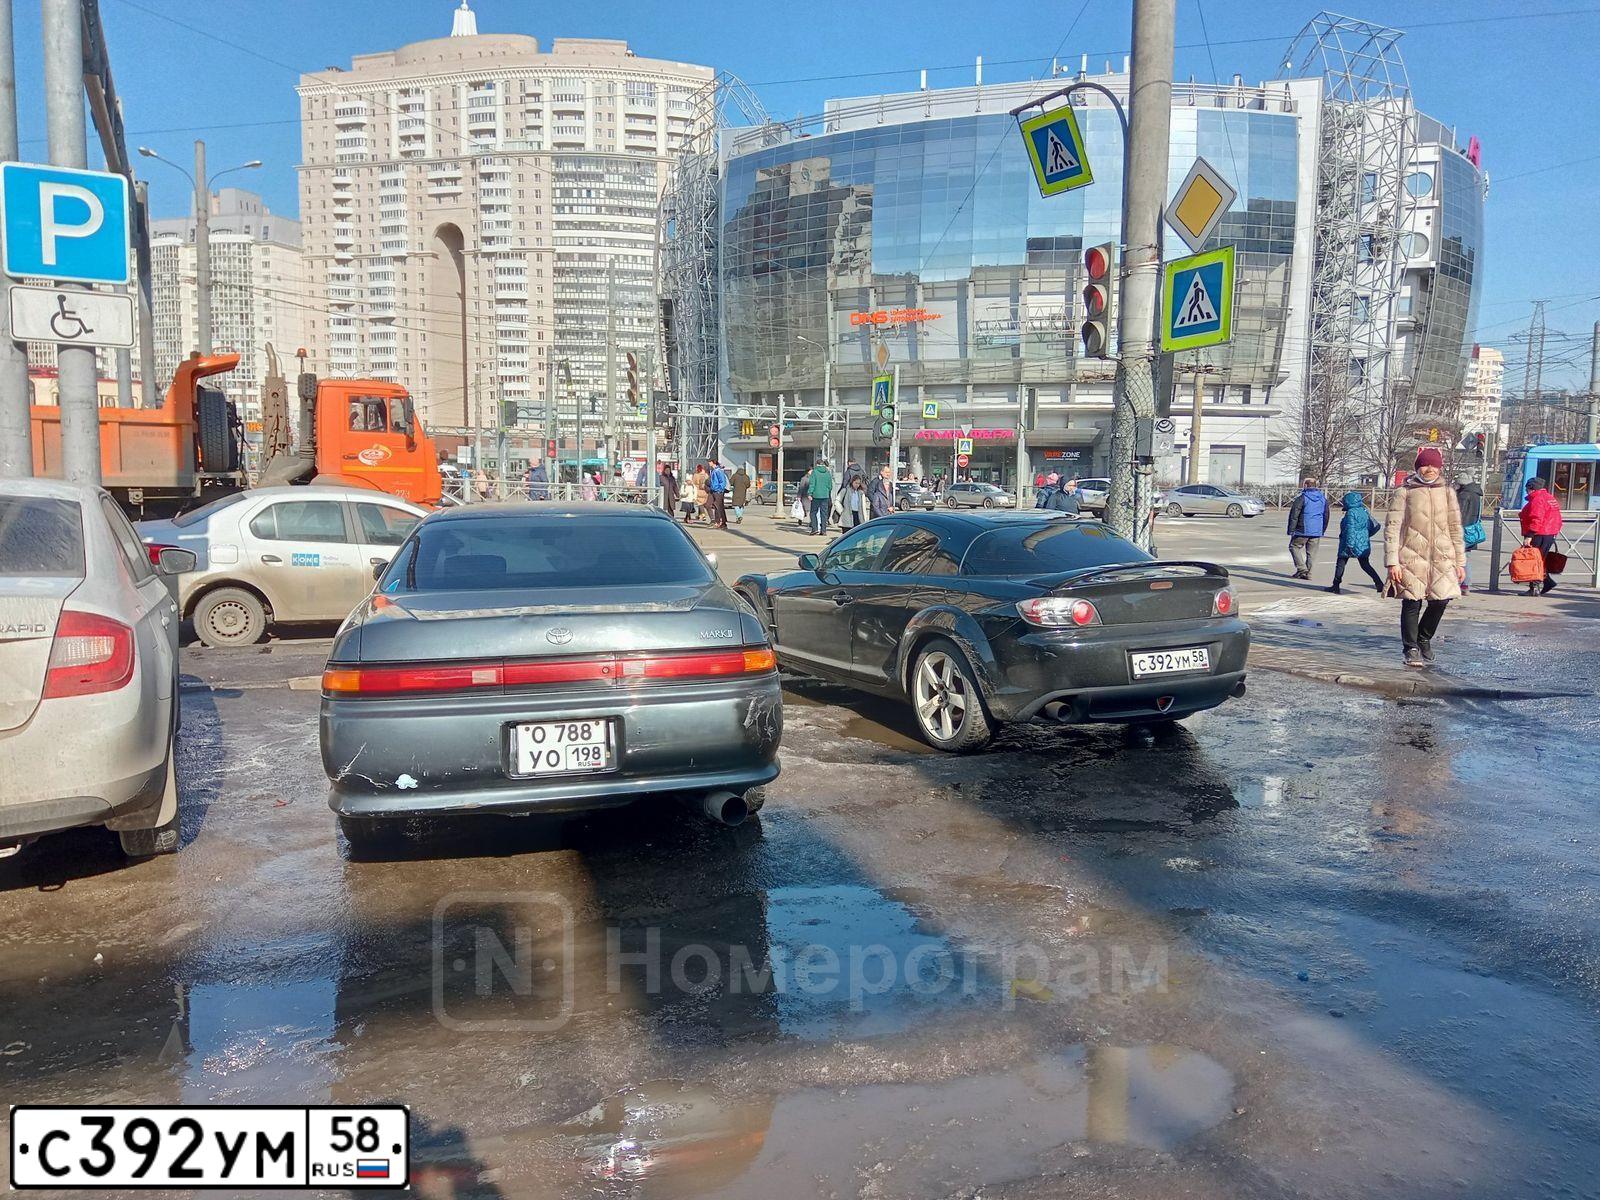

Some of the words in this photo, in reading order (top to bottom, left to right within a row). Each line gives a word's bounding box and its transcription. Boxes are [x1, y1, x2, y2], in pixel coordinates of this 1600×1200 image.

[39, 181, 104, 266] P
[850, 310, 887, 325] DNS
[915, 428, 1015, 440] АТМОФЕРА
[292, 555, 319, 564] KONE
[1139, 654, 1190, 671] С392УМ
[1192, 651, 1204, 662] 58
[555, 723, 592, 742] 788
[529, 749, 560, 769] УО
[572, 746, 601, 761] 198
